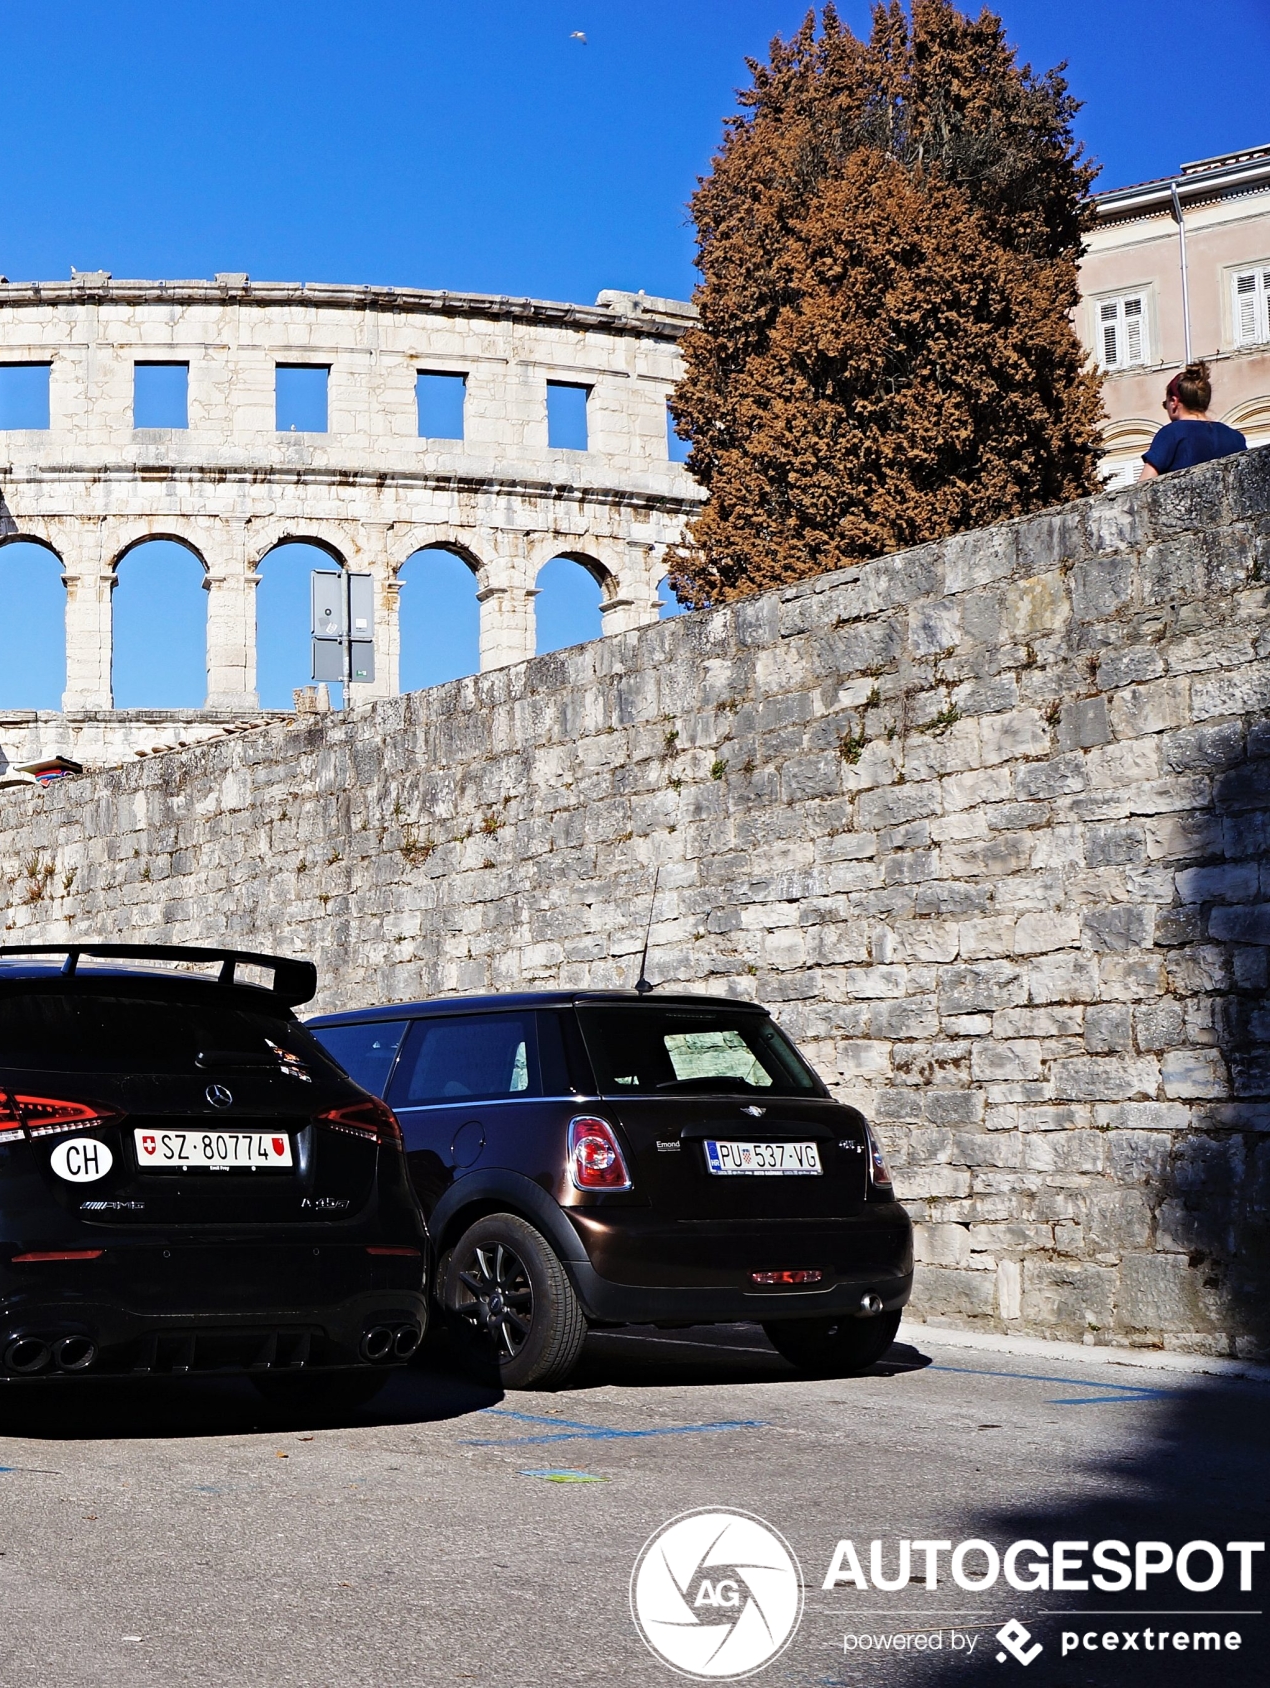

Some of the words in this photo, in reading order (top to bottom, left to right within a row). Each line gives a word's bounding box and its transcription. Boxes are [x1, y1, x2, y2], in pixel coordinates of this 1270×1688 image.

[656, 1140, 681, 1148] Emond
[66, 1144, 99, 1176] CH
[720, 1145, 742, 1167] PU
